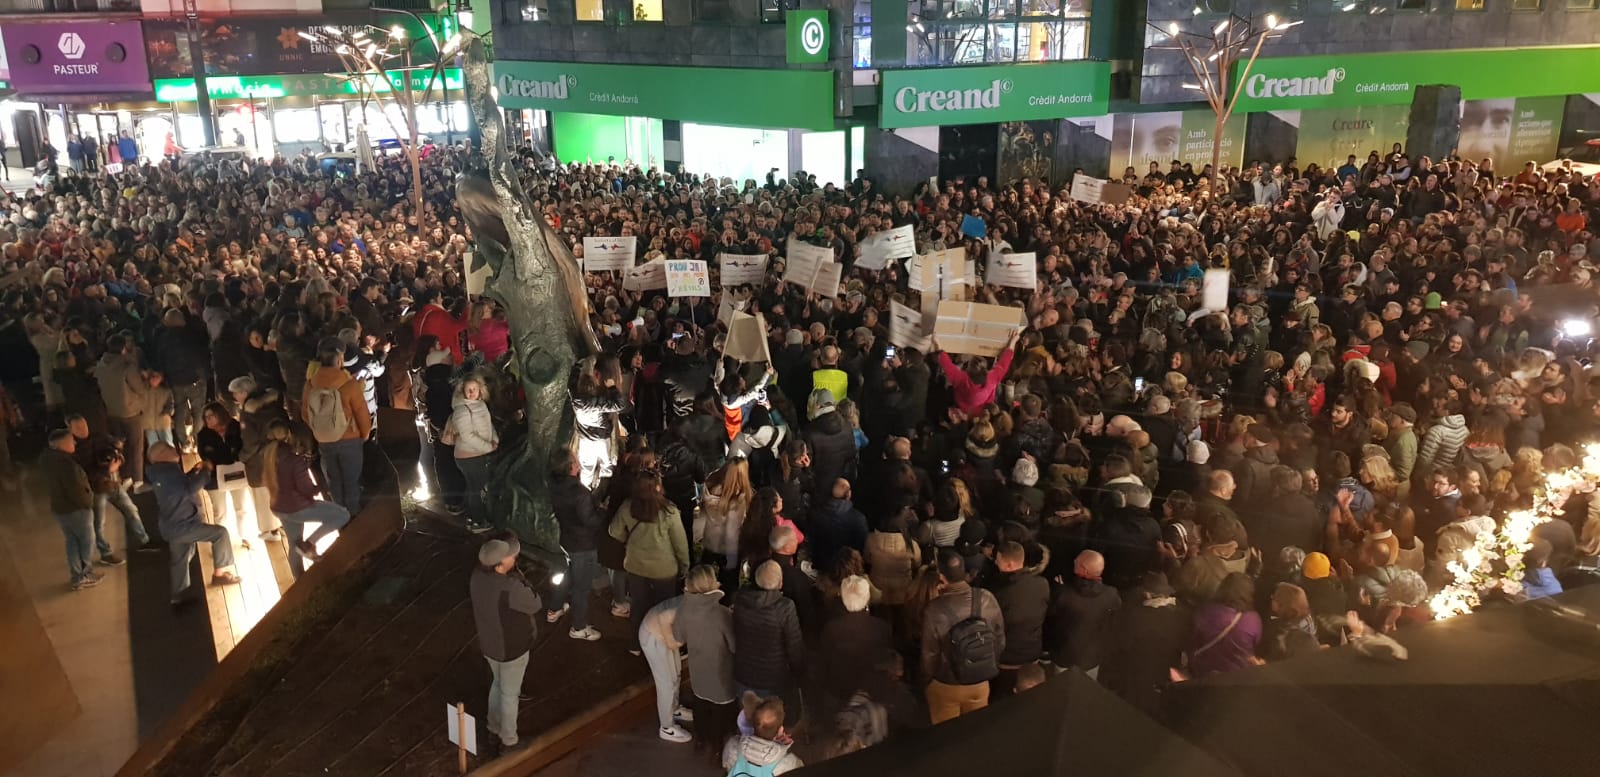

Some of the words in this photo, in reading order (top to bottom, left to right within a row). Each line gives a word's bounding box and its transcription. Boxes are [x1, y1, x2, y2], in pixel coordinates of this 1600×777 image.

[53, 64, 99, 75] PASTEUR
[1355, 82, 1379, 94] Crèdit
[1380, 81, 1409, 93] Andorrà
[589, 92, 610, 103] Crèdit
[611, 93, 639, 104] Andorrà
[1028, 95, 1056, 107] Crèdit
[1057, 93, 1093, 105] Andorrà
[1188, 129, 1206, 138] Amb
[1186, 137, 1232, 151] participció
